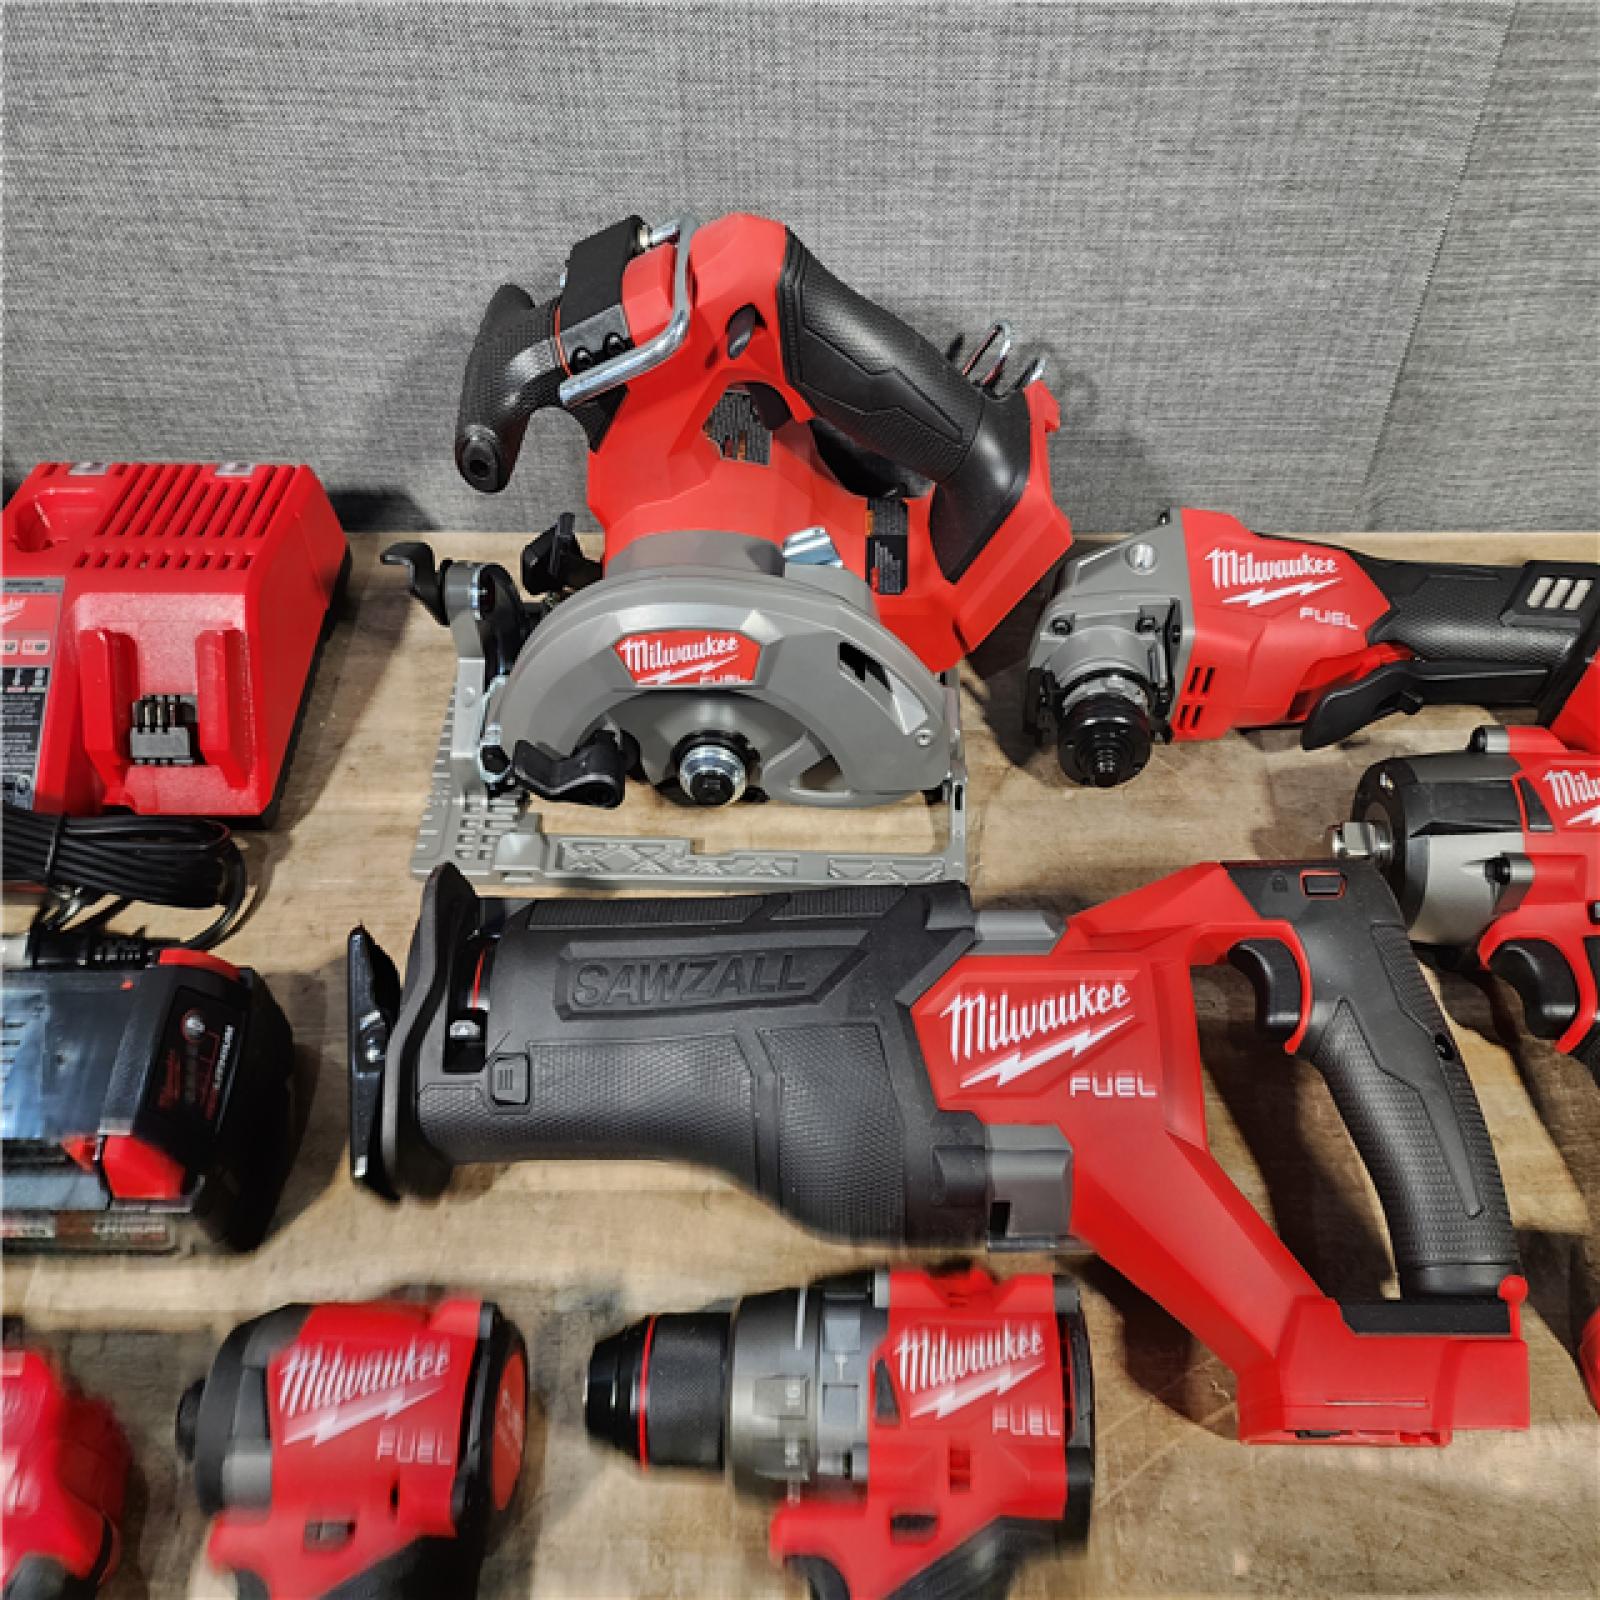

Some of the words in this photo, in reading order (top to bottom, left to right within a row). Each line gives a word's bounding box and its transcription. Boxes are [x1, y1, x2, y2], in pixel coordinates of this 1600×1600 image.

[1204, 547, 1341, 590] Milwaukee
[1299, 606, 1359, 631] FUEL
[618, 634, 739, 673] Milwaukee
[571, 951, 808, 1009] SAWZALL
[938, 976, 1132, 1067] Milwaukee
[1069, 1071, 1159, 1099] FUEL
[278, 1335, 451, 1419] Milwaukee
[893, 1320, 1047, 1395] Milwaukee
[991, 1402, 1061, 1437] FUEL
[375, 1427, 453, 1466] FUEL
